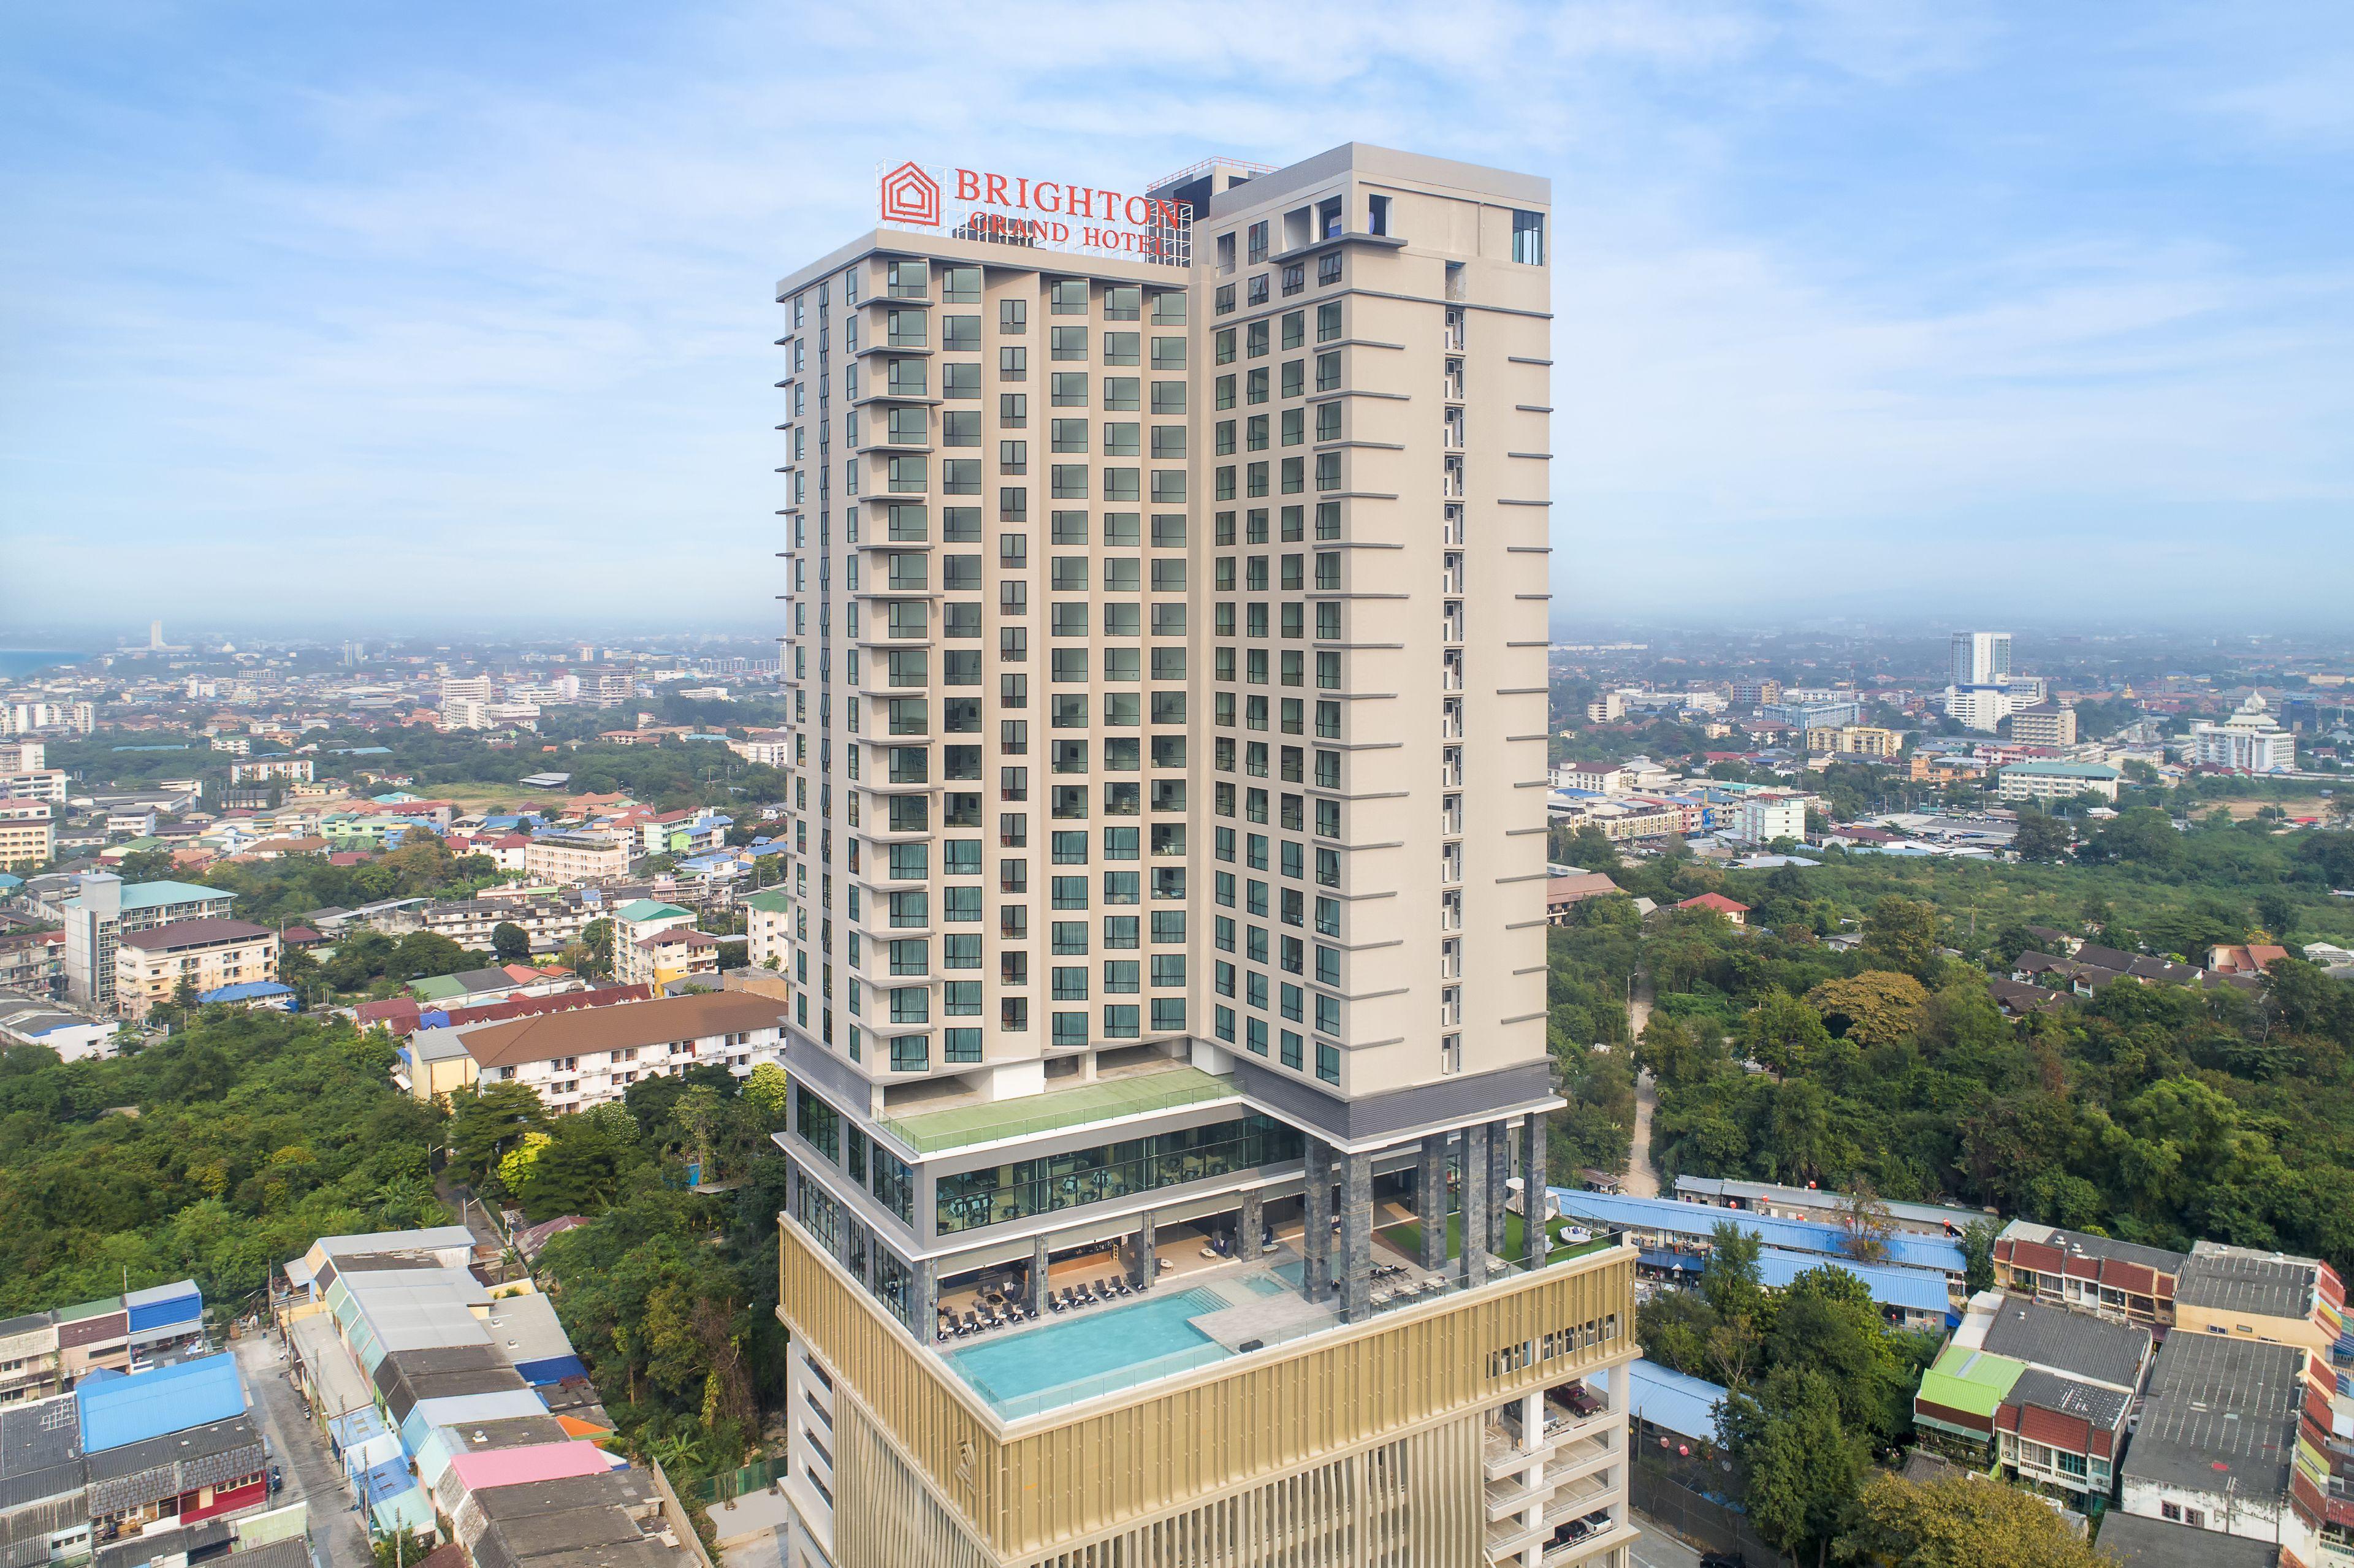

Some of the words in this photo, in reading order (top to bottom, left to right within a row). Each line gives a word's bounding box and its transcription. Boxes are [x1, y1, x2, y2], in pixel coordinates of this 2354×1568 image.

[955, 168, 1180, 230] BRIGHTON
[970, 211, 1069, 242] GRAND
[1083, 227, 1169, 255] HOTEL
